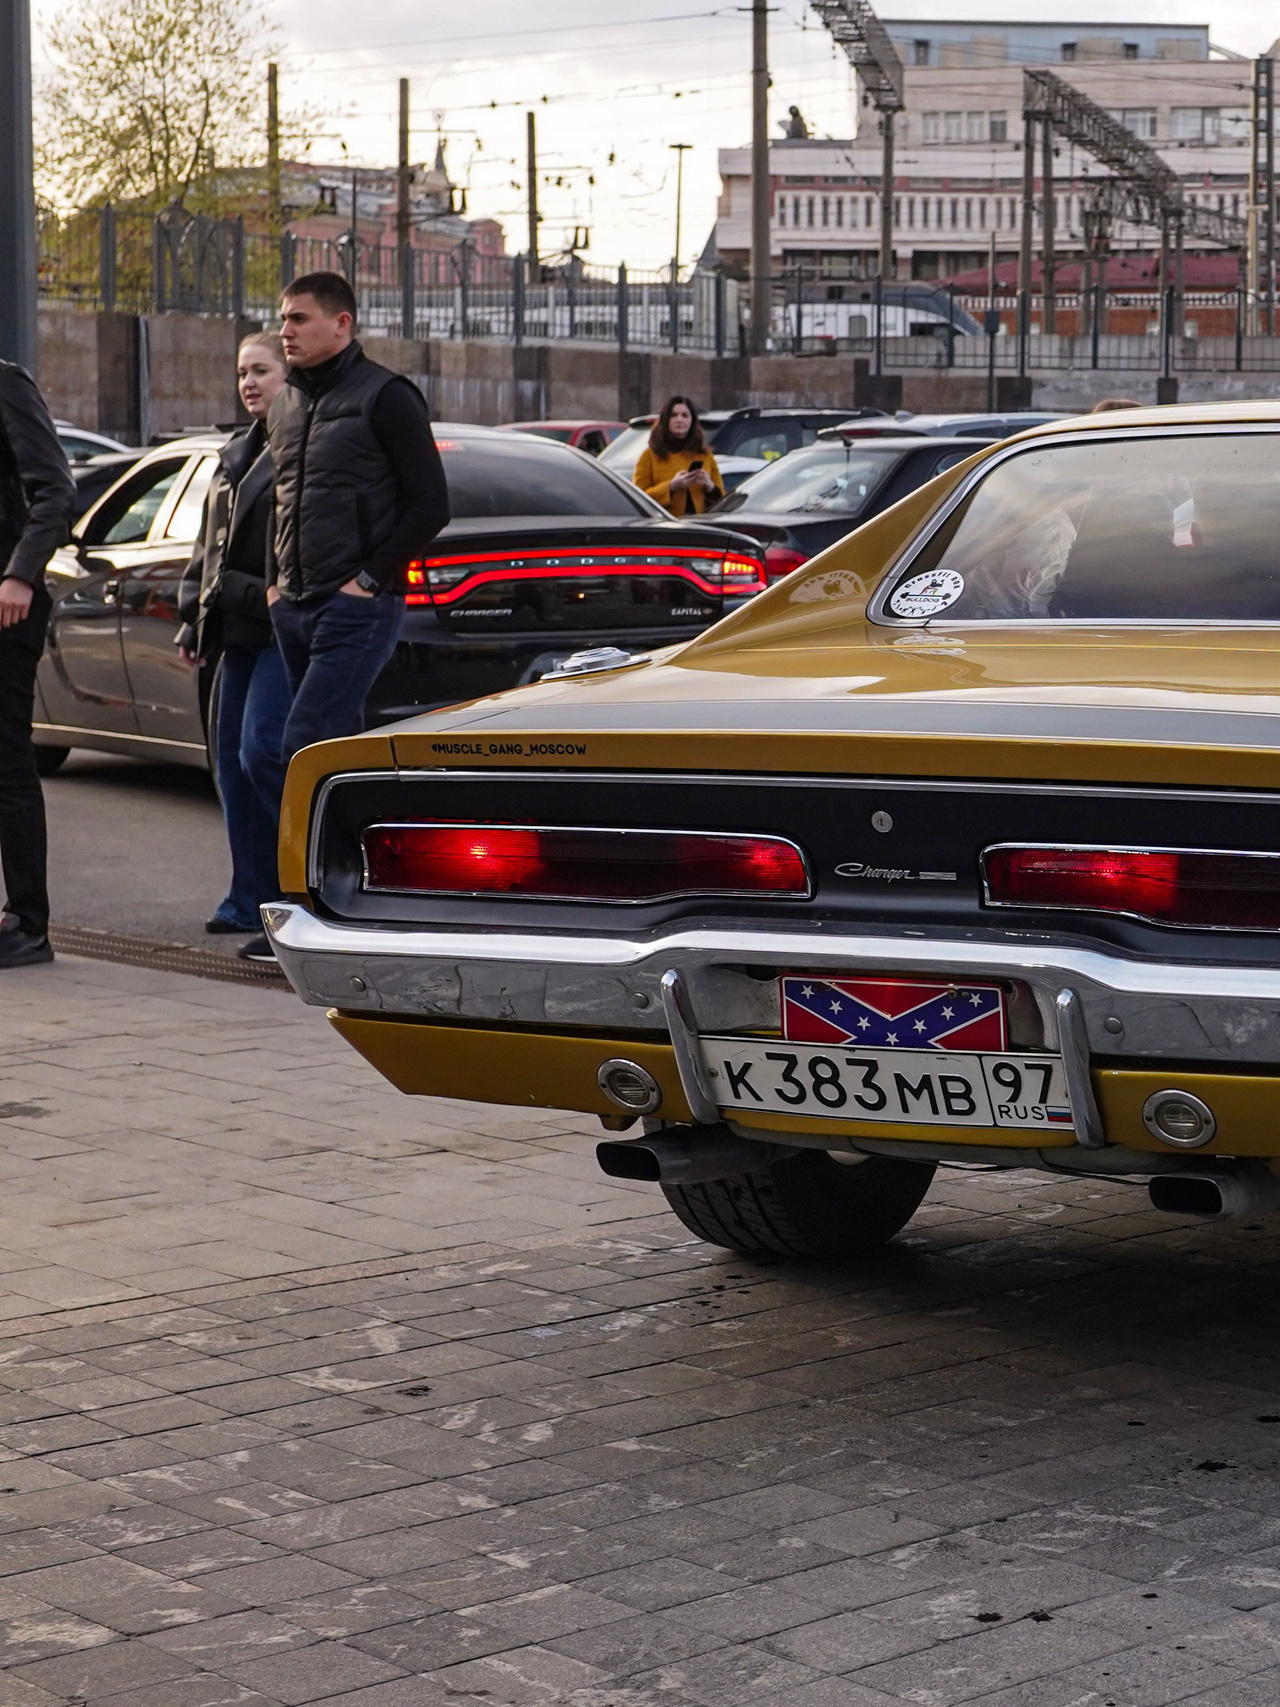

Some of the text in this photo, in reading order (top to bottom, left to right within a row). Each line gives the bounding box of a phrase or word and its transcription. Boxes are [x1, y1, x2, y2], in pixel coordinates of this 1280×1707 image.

[834, 862, 915, 883] Charger
[992, 1062, 1053, 1104] 97
[999, 1104, 1045, 1120] RUS
